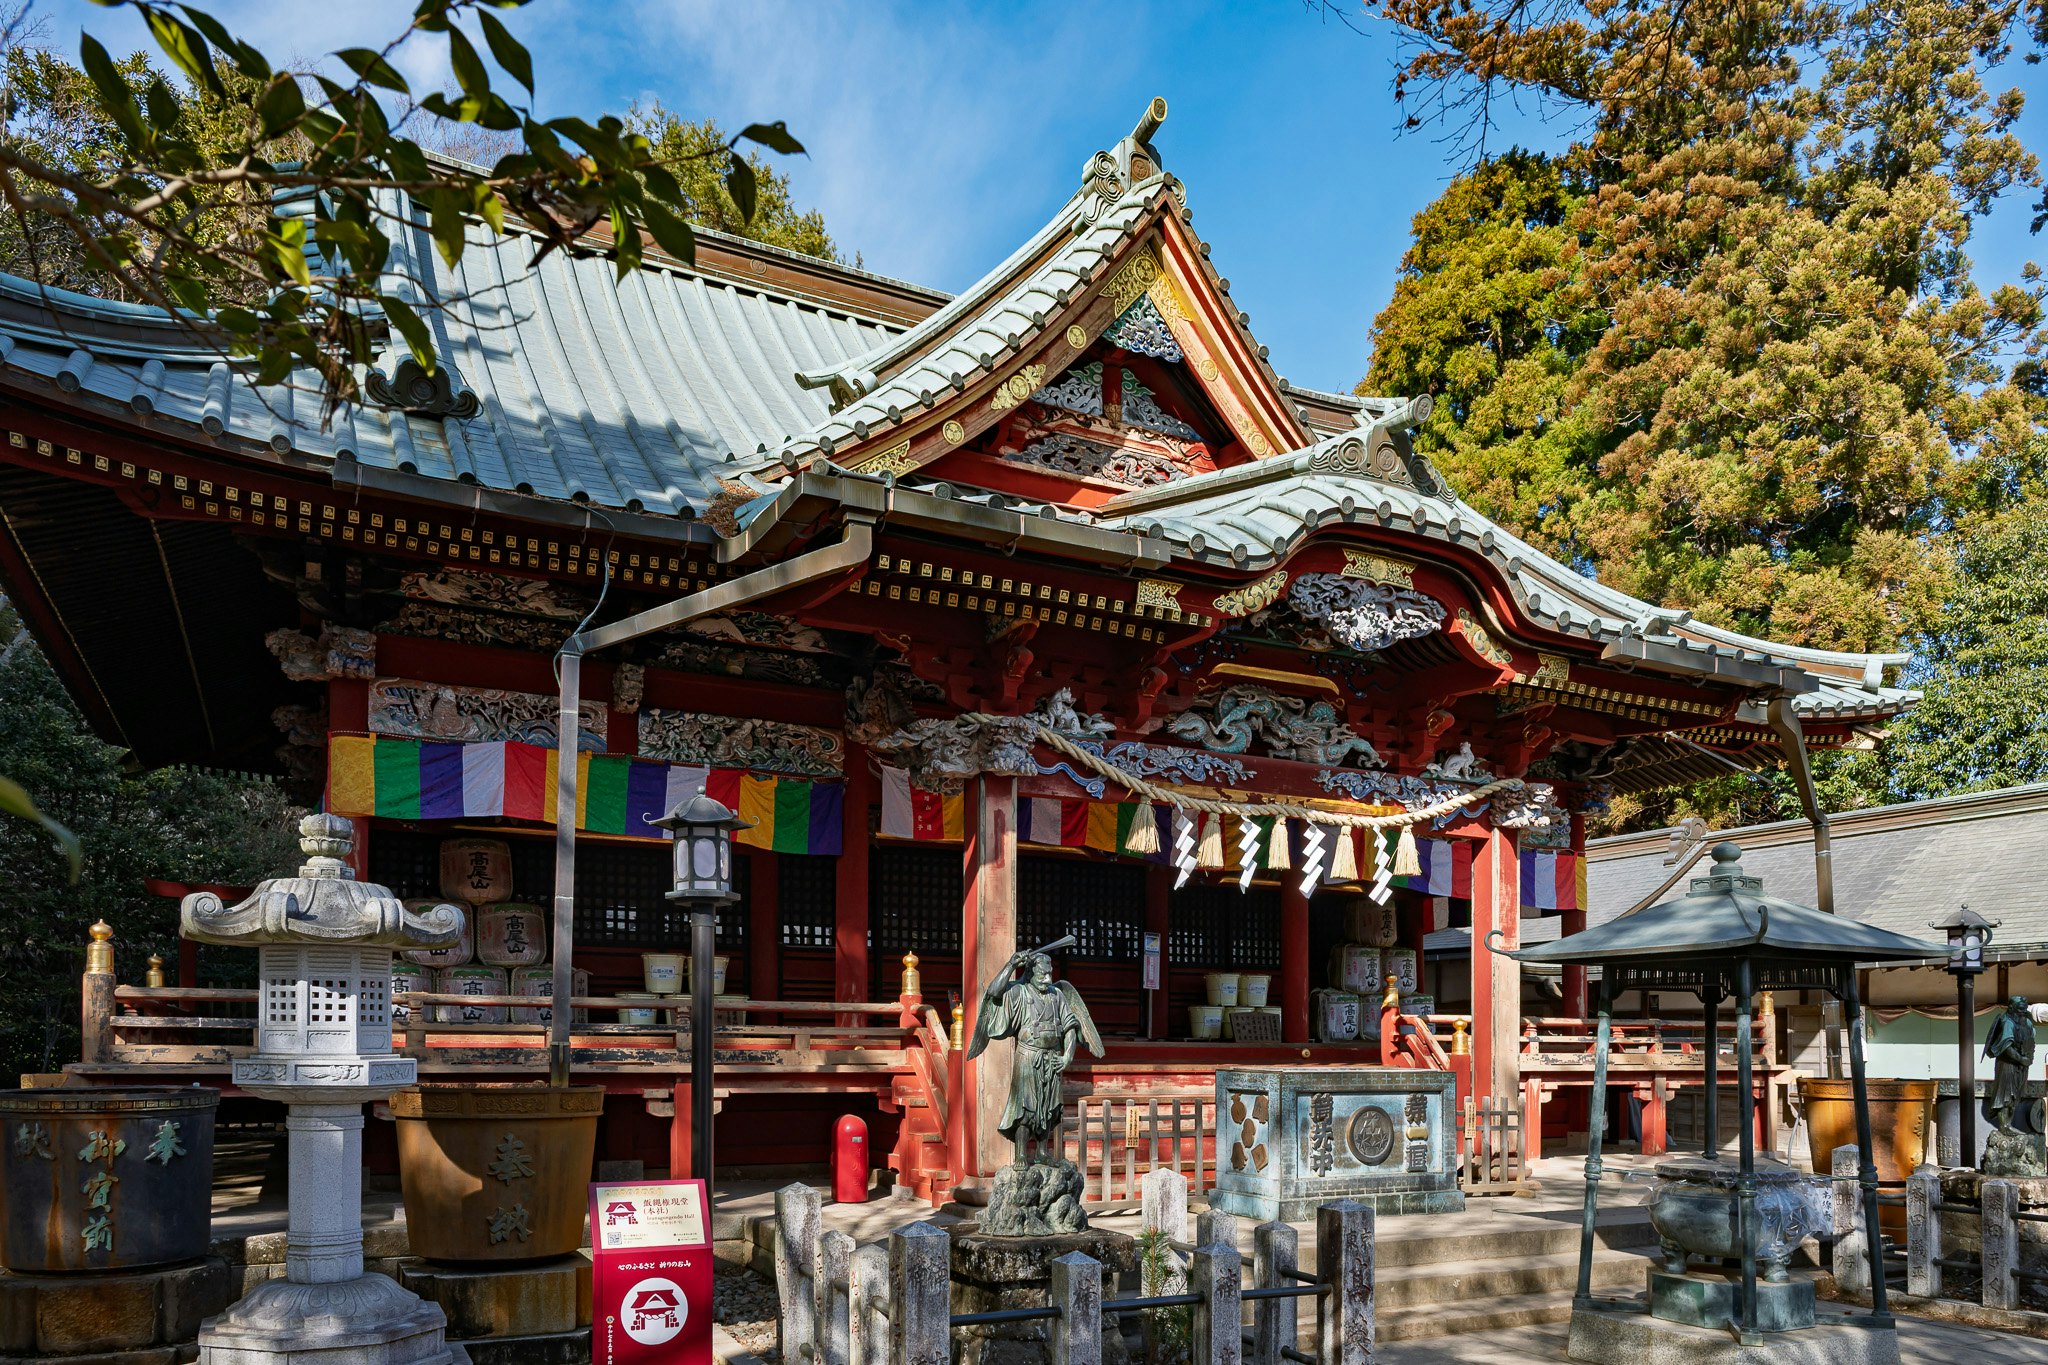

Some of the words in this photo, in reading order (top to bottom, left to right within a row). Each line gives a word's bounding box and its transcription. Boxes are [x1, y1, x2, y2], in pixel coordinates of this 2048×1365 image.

[486, 1132, 536, 1246] 奉納
[617, 1262, 655, 1271] 心のふるさと
